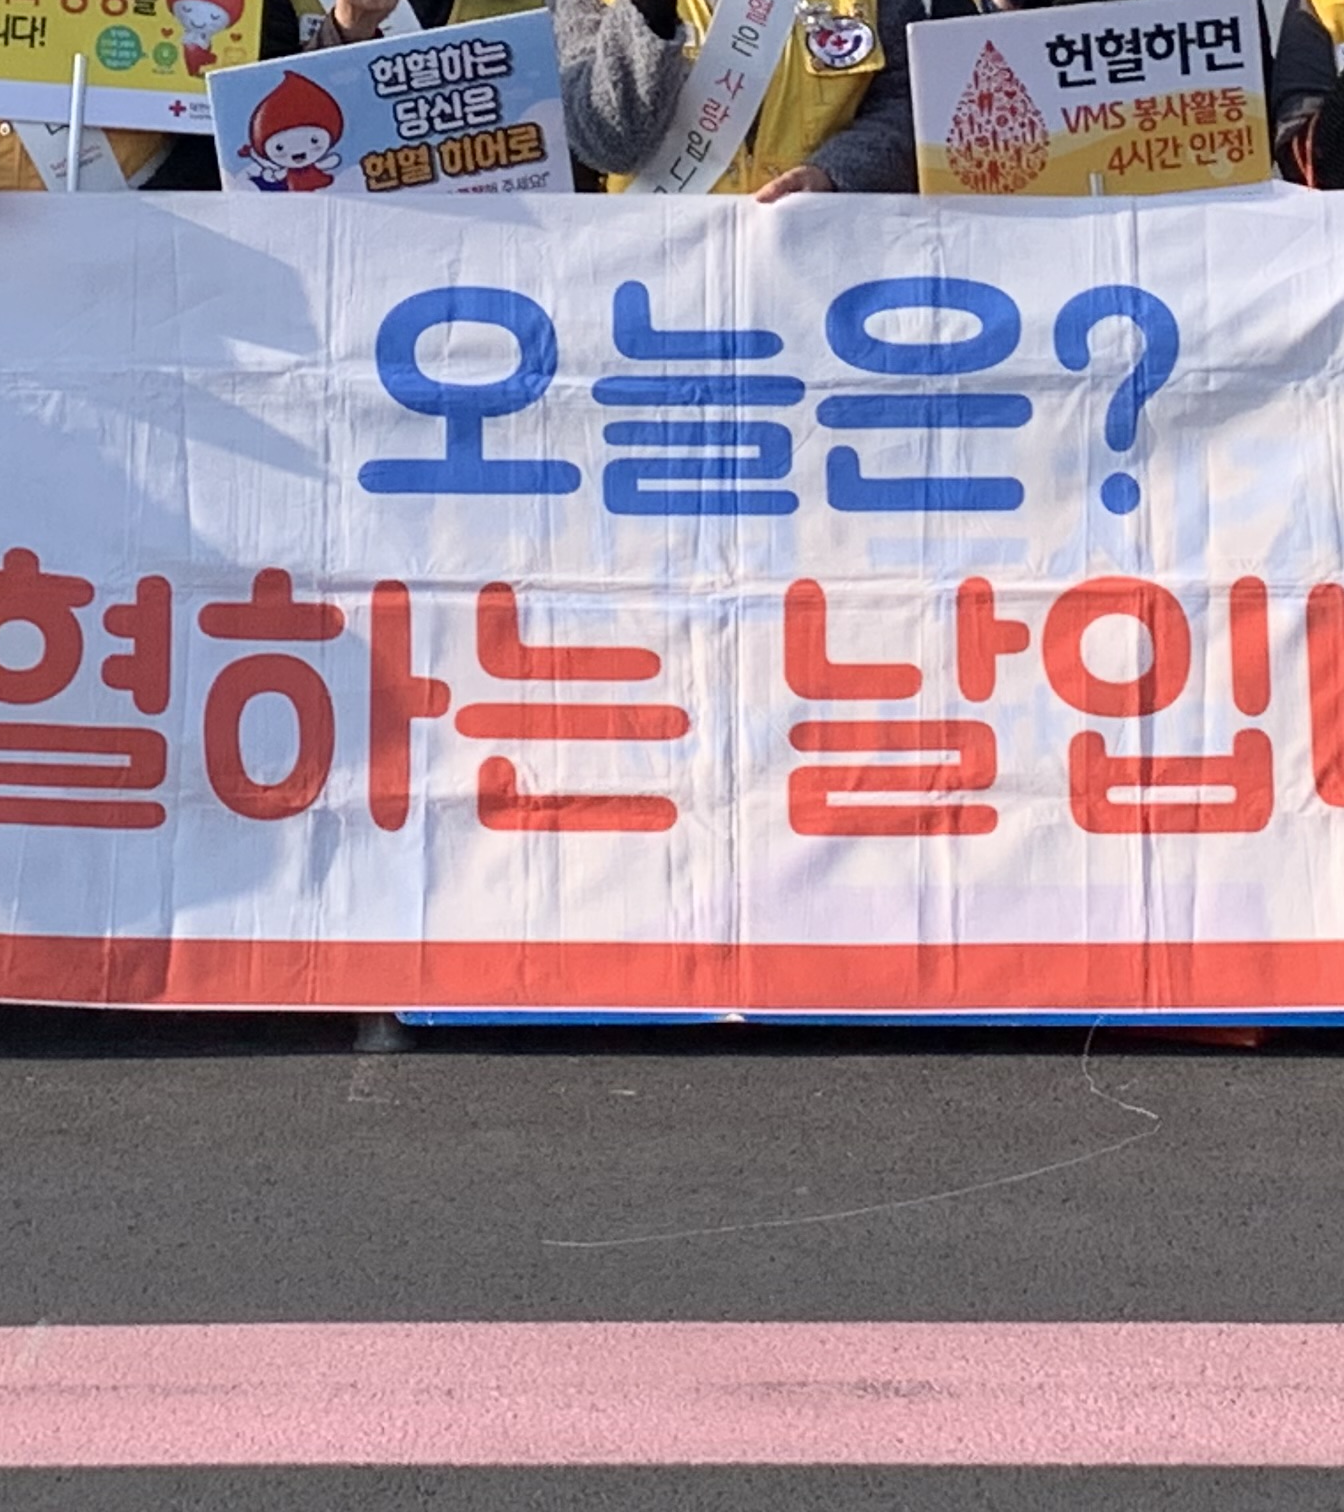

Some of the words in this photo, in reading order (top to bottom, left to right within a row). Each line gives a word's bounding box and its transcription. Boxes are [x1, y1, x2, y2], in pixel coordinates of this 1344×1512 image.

[369, 39, 513, 98] 헌혈하는
[1045, 15, 1245, 89] 헌혈하면
[394, 84, 501, 139] 당신은
[654, 68, 745, 192] 사랑입니
[1060, 100, 1127, 134] VMS
[1132, 86, 1249, 132] 봉사활동
[361, 143, 435, 192] 헌혈
[438, 122, 547, 177] 히어로
[1107, 136, 1183, 176] 4시간
[1189, 125, 1255, 167] 인정!
[357, 276, 1181, 516] 오늘은?
